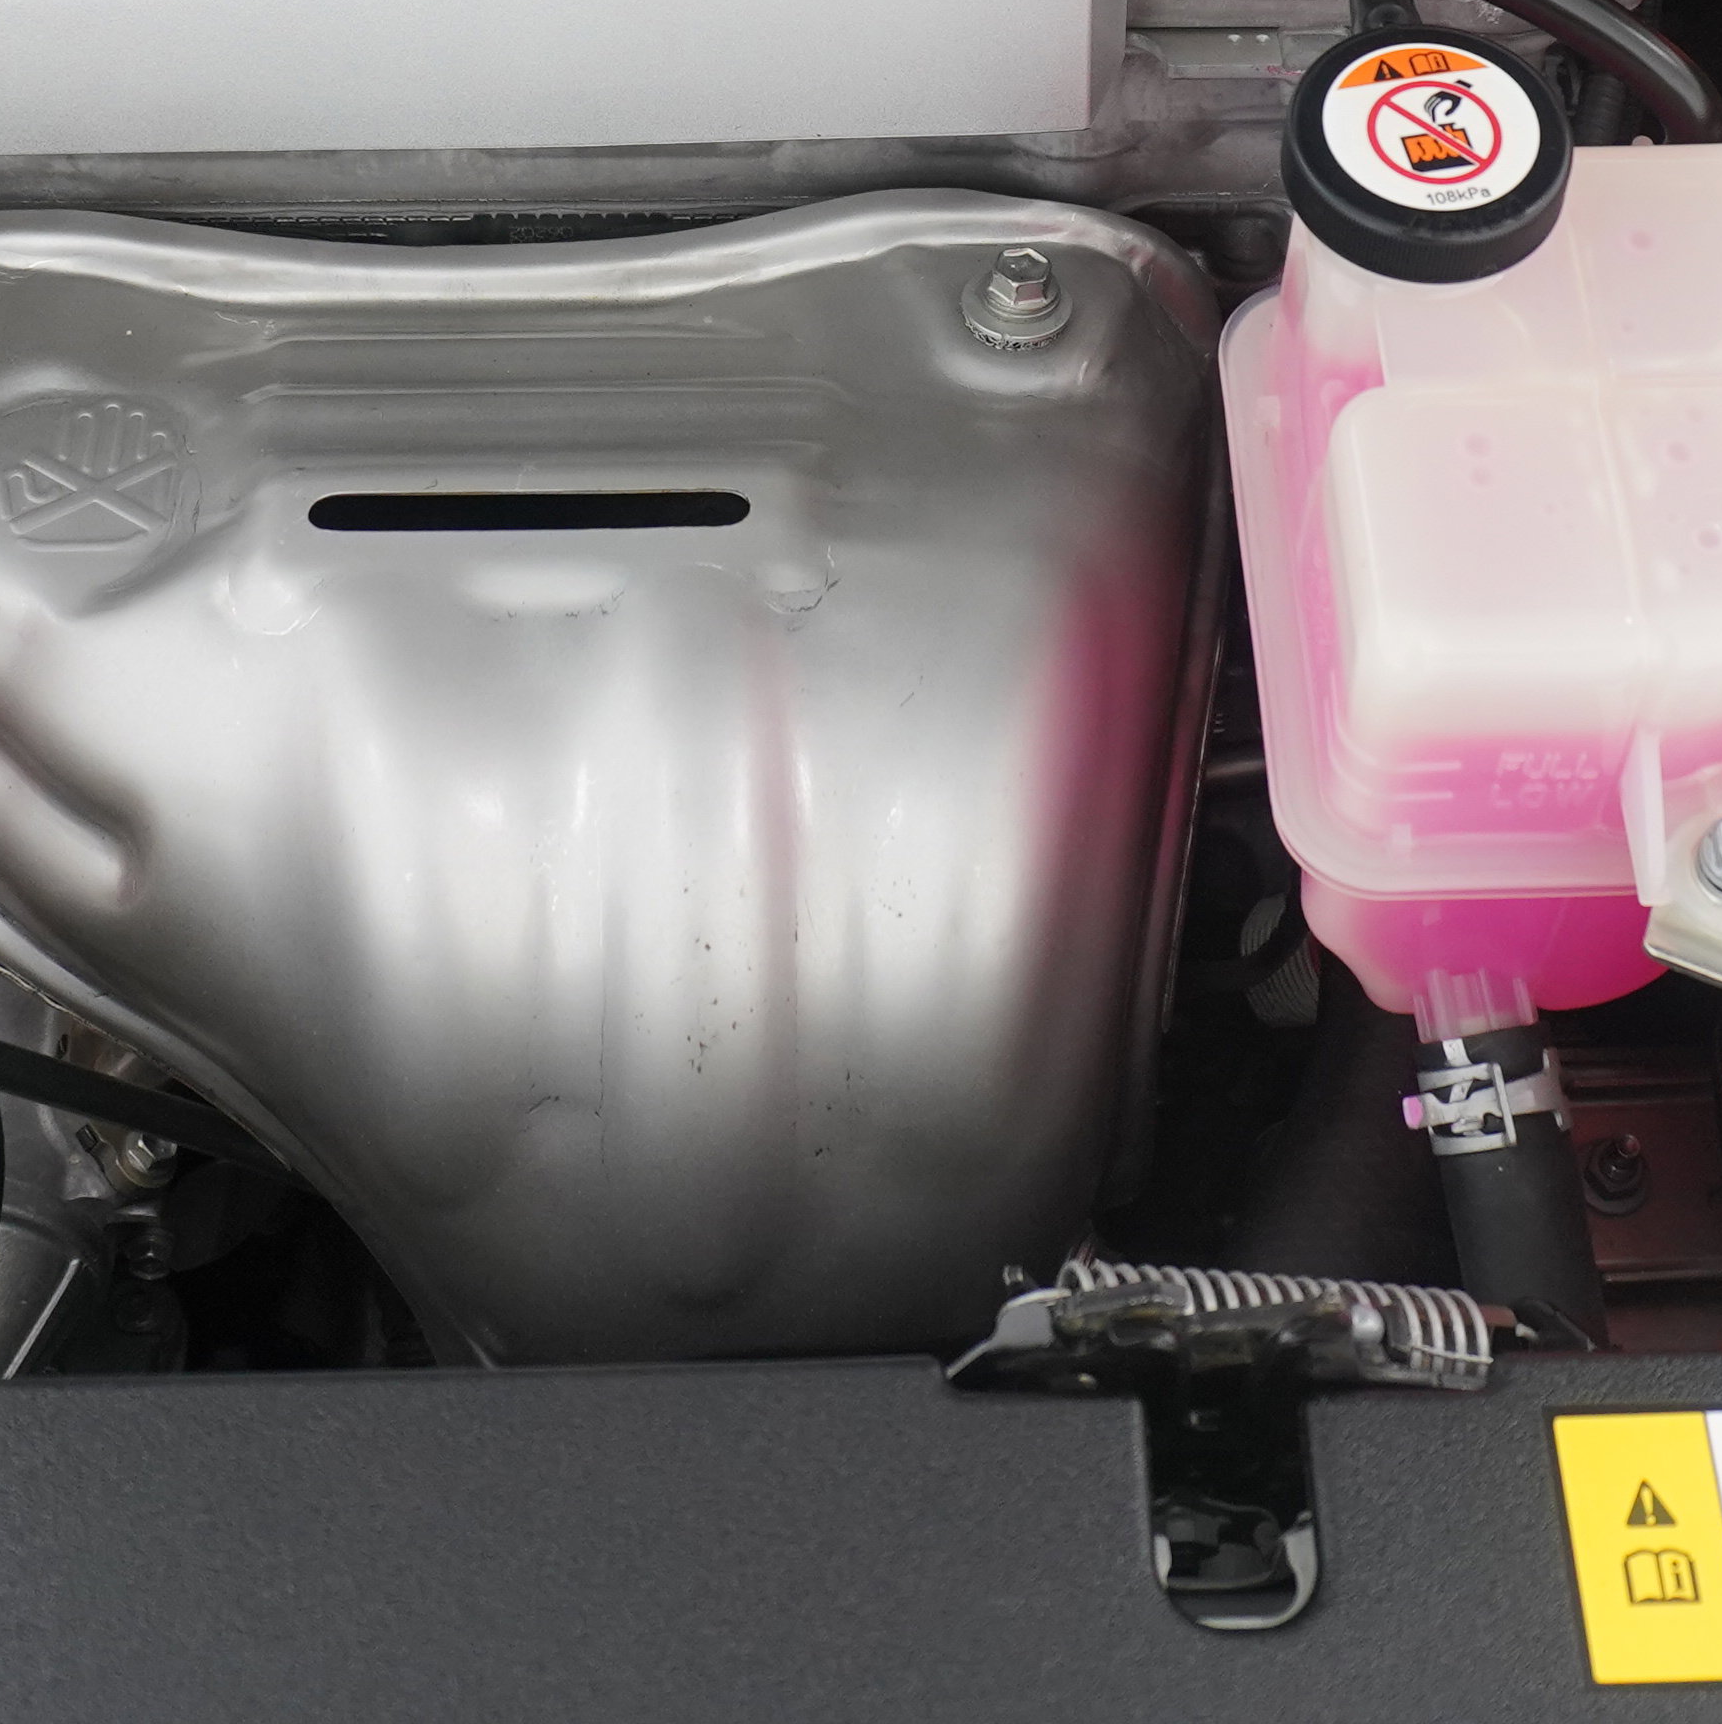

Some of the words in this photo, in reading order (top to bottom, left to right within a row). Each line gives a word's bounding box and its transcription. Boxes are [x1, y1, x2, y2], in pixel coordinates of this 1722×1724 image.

[1426, 186, 1492, 206] 108kPa
[1495, 751, 1599, 780] FULL
[1489, 781, 1595, 809] LOW
